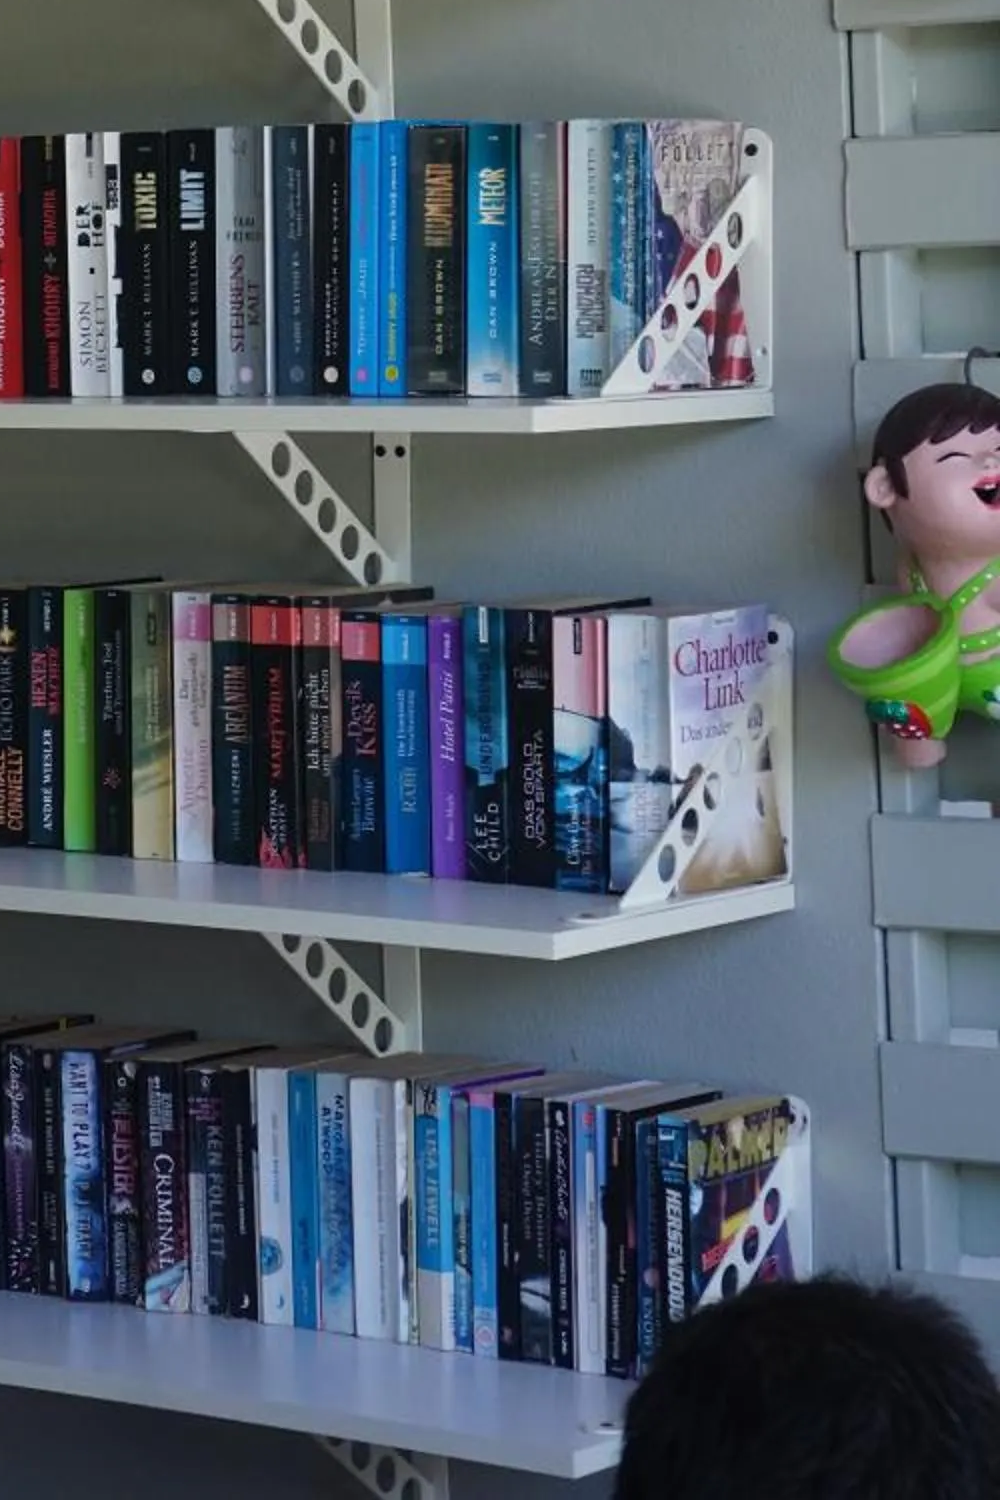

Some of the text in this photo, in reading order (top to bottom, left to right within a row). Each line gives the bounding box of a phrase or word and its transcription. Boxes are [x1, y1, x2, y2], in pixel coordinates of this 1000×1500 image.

[661, 141, 734, 163] FOLLETT
[75, 202, 92, 367] SIMON DER
[90, 200, 108, 374] BECKETT HOF
[133, 171, 157, 356] MARK SULLIVAN TOXIC
[179, 168, 205, 357] MARK SULLIVAN LIMIT
[434, 259, 445, 315] BROWN
[476, 167, 506, 338] DAN BROWN METEOR
[44, 274, 61, 340] KHOURY
[230, 254, 244, 353] STERBENS
[247, 280, 260, 326] KALT
[434, 323, 444, 356] DAN
[528, 267, 544, 346] ANDREAS
[0, 655, 12, 693] PARK
[674, 632, 768, 673] Charlotte
[0, 697, 13, 740] ECHO
[223, 665, 249, 743] ARCANUM
[269, 668, 285, 778] MARTYRIUM
[306, 675, 319, 771] Ich bitte nicht
[478, 663, 493, 776] UNDERGROUND
[681, 724, 702, 743] Das
[703, 676, 745, 712] Link
[31, 650, 53, 831] ANDRÉ WIESLER HEXEN
[440, 718, 455, 761] Hotel
[7, 745, 24, 831] CONNELLY
[523, 742, 535, 839] DAS GOLD
[532, 729, 546, 848] VON SPARTA
[474, 813, 488, 848] LEE
[487, 802, 502, 862] CHILD
[67, 1062, 93, 1259] WANT TO PLAY? TRACY
[112, 1134, 135, 1195] JESTER
[322, 1106, 333, 1175] ATWOOD
[153, 1153, 176, 1269] CRIMINAL
[207, 1125, 226, 1259] KEN FOLLETT
[425, 1127, 439, 1248] LISA JEWELL
